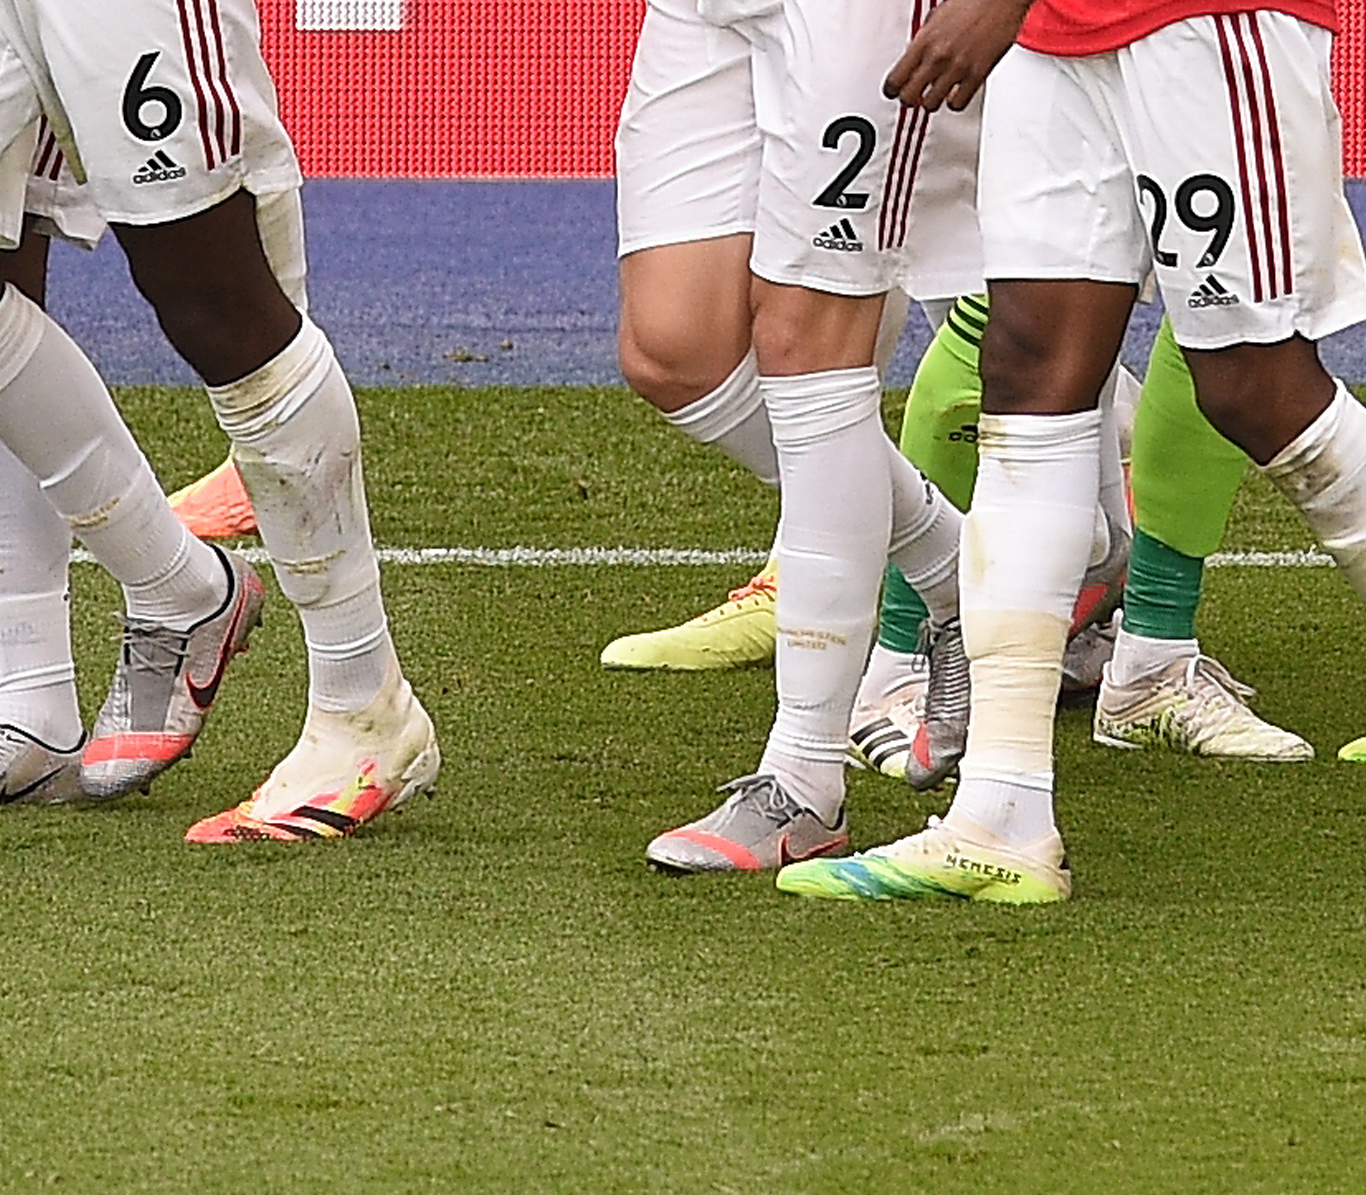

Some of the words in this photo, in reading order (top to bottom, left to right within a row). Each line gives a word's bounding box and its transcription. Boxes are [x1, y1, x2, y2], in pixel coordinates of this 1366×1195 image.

[121, 50, 183, 142] 6
[133, 166, 186, 184] adidas
[811, 115, 877, 210] 2
[813, 236, 864, 252] adidas
[1136, 173, 1236, 269] 29
[945, 853, 1022, 884] NEMESIS
